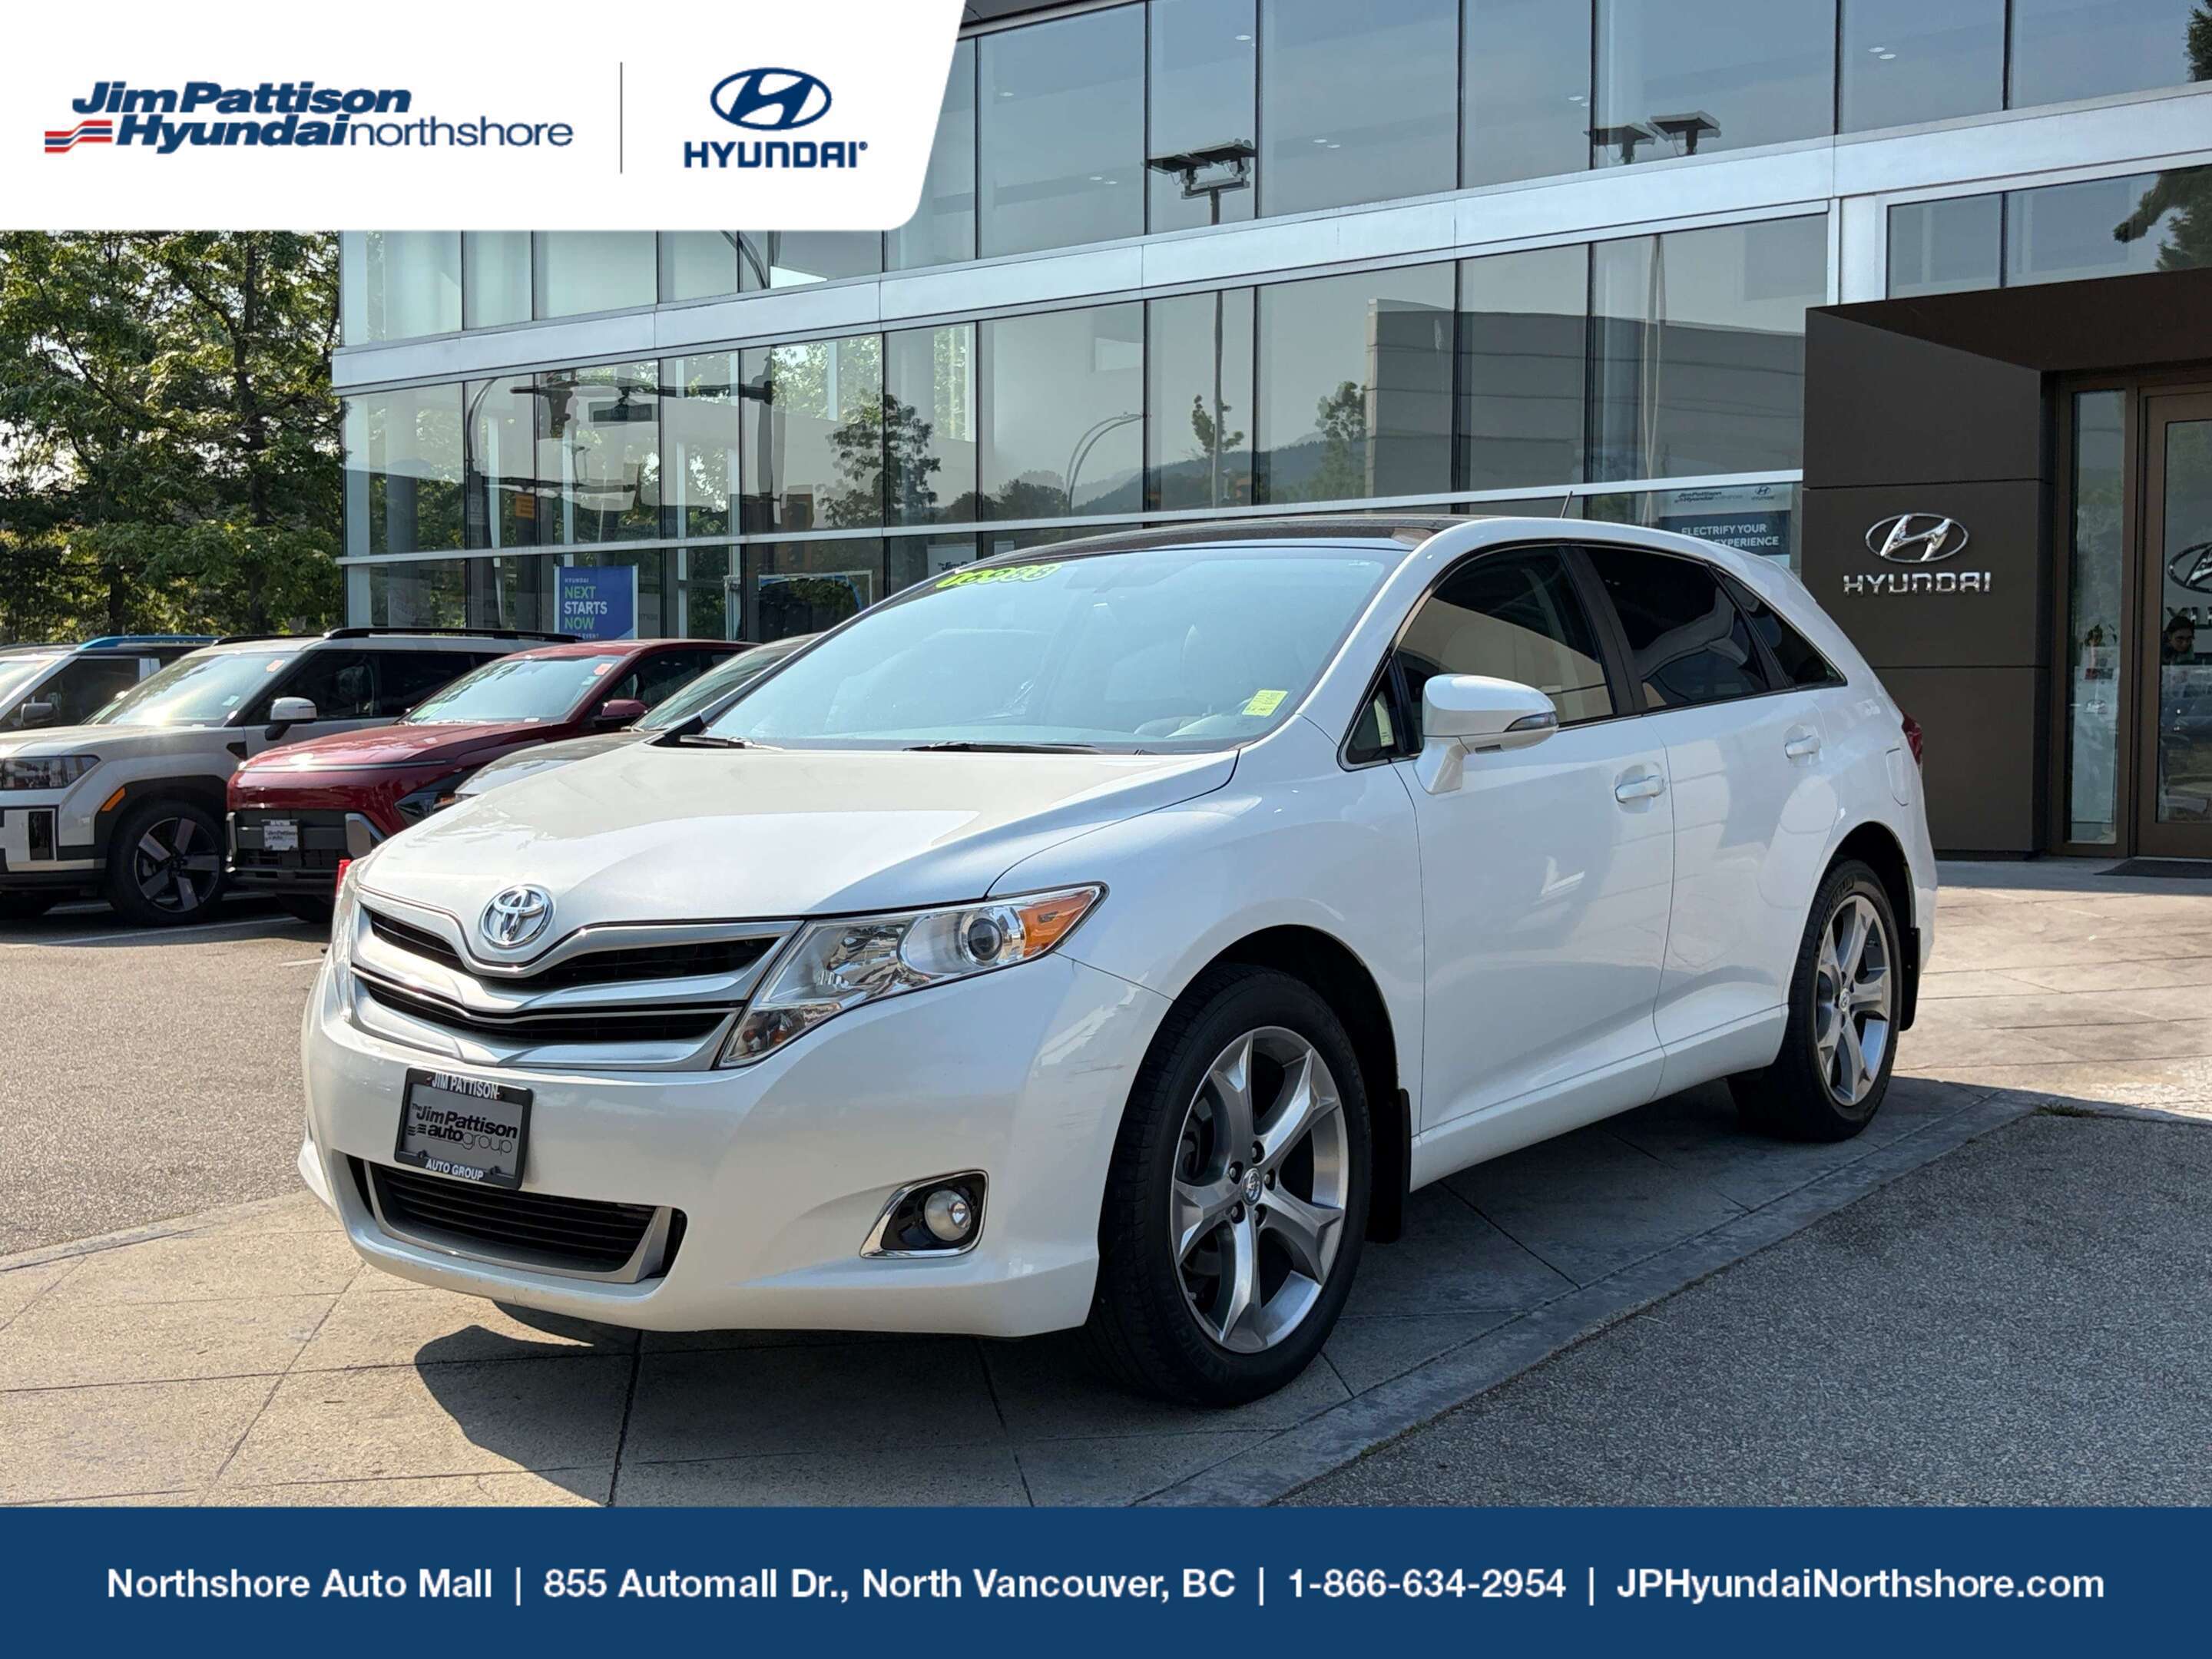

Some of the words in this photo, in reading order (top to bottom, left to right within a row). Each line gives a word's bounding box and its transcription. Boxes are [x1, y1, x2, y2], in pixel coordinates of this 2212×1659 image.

[1681, 525, 1736, 536] ELECTRIFY
[1737, 524, 1767, 534] YOUR
[1715, 536, 1779, 547] EXPERIENCE
[1843, 571, 1991, 595] HYUNDAI
[565, 586, 596, 599] NEXT
[564, 601, 608, 614] STARTS
[565, 617, 594, 630] NOW
[432, 1073, 448, 1089] JIM
[450, 1076, 498, 1100] PATTISON
[426, 1158, 450, 1174] AUTO
[452, 1164, 484, 1181] GROUP
